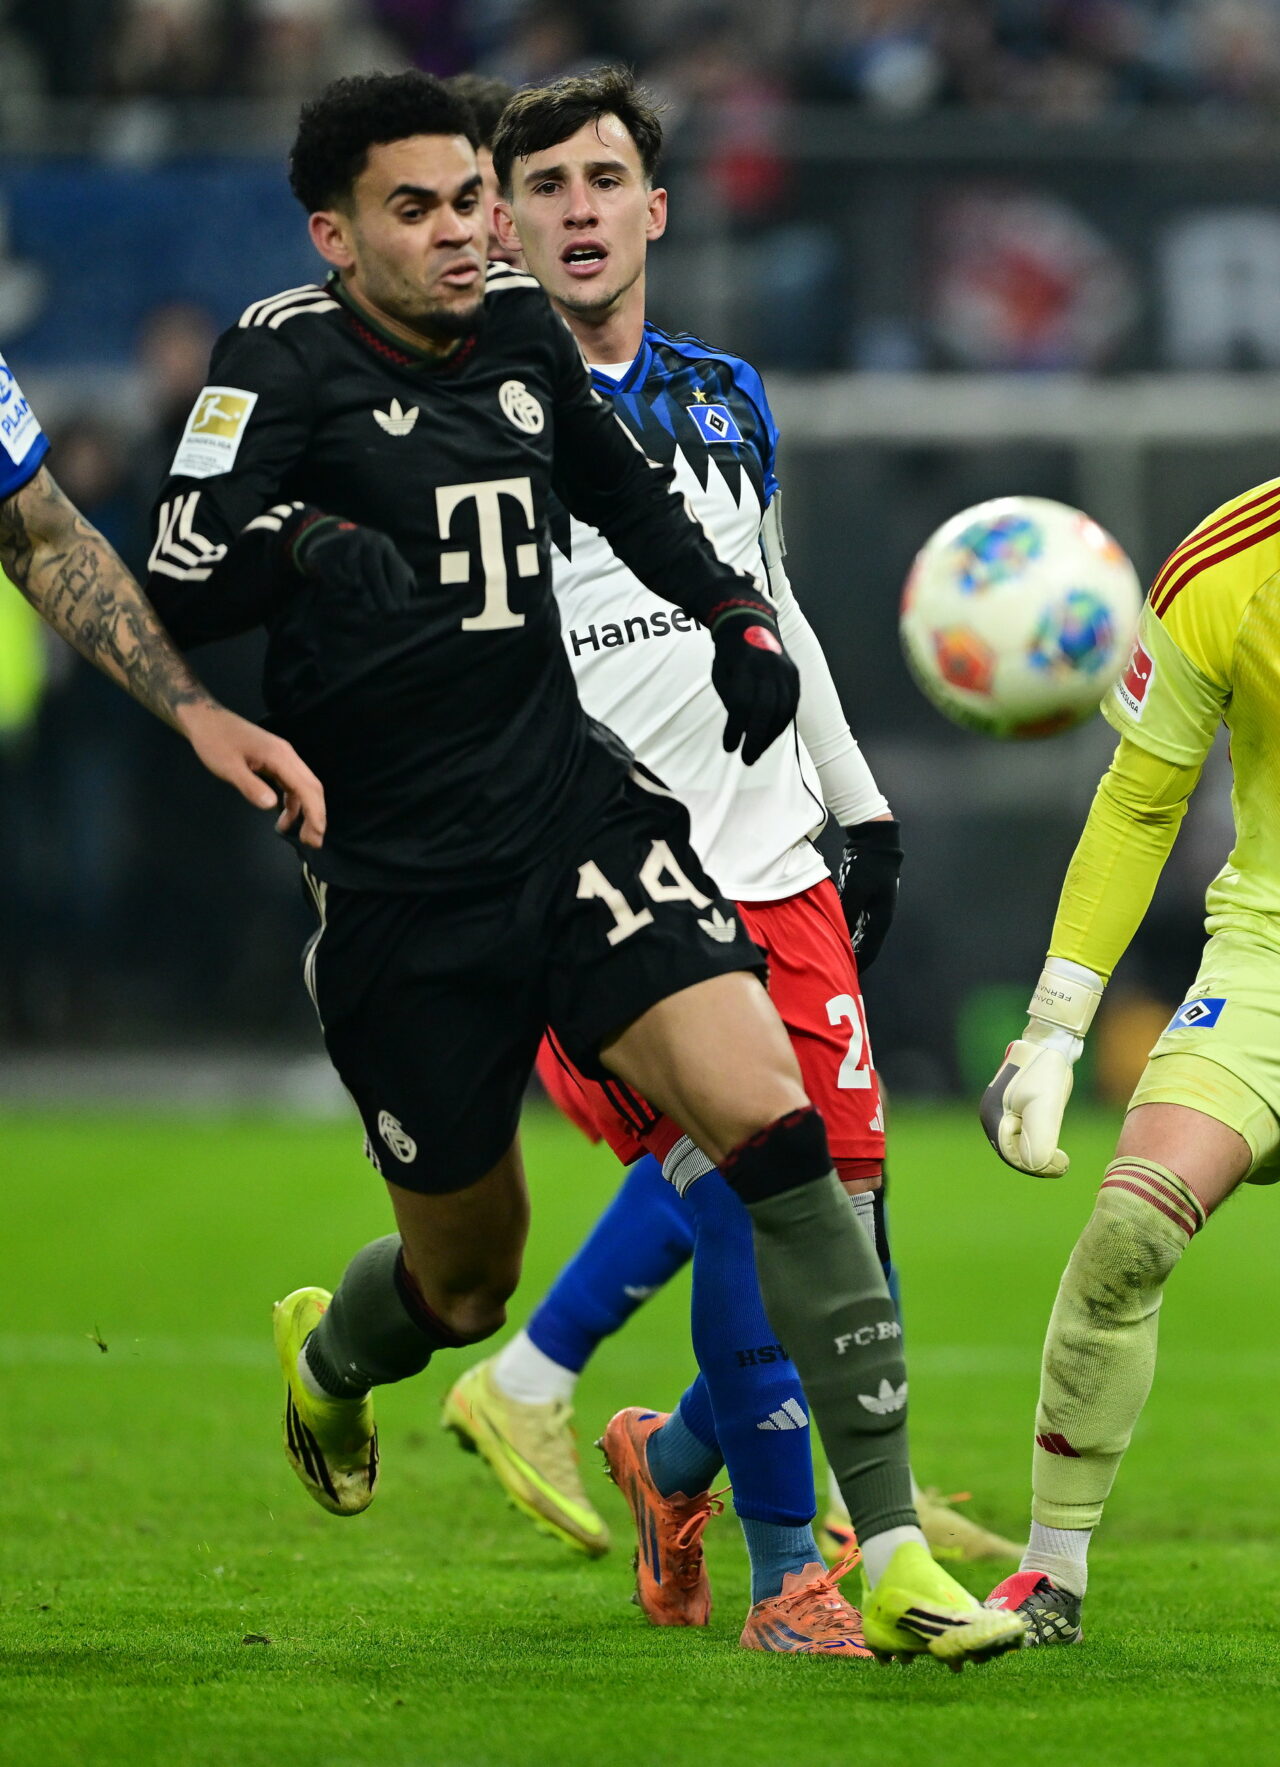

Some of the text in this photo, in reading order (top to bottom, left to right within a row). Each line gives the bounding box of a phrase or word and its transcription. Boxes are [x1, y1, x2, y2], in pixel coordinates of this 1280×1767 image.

[435, 476, 540, 632] T
[569, 606, 701, 657] Hanse
[576, 839, 714, 946] 14
